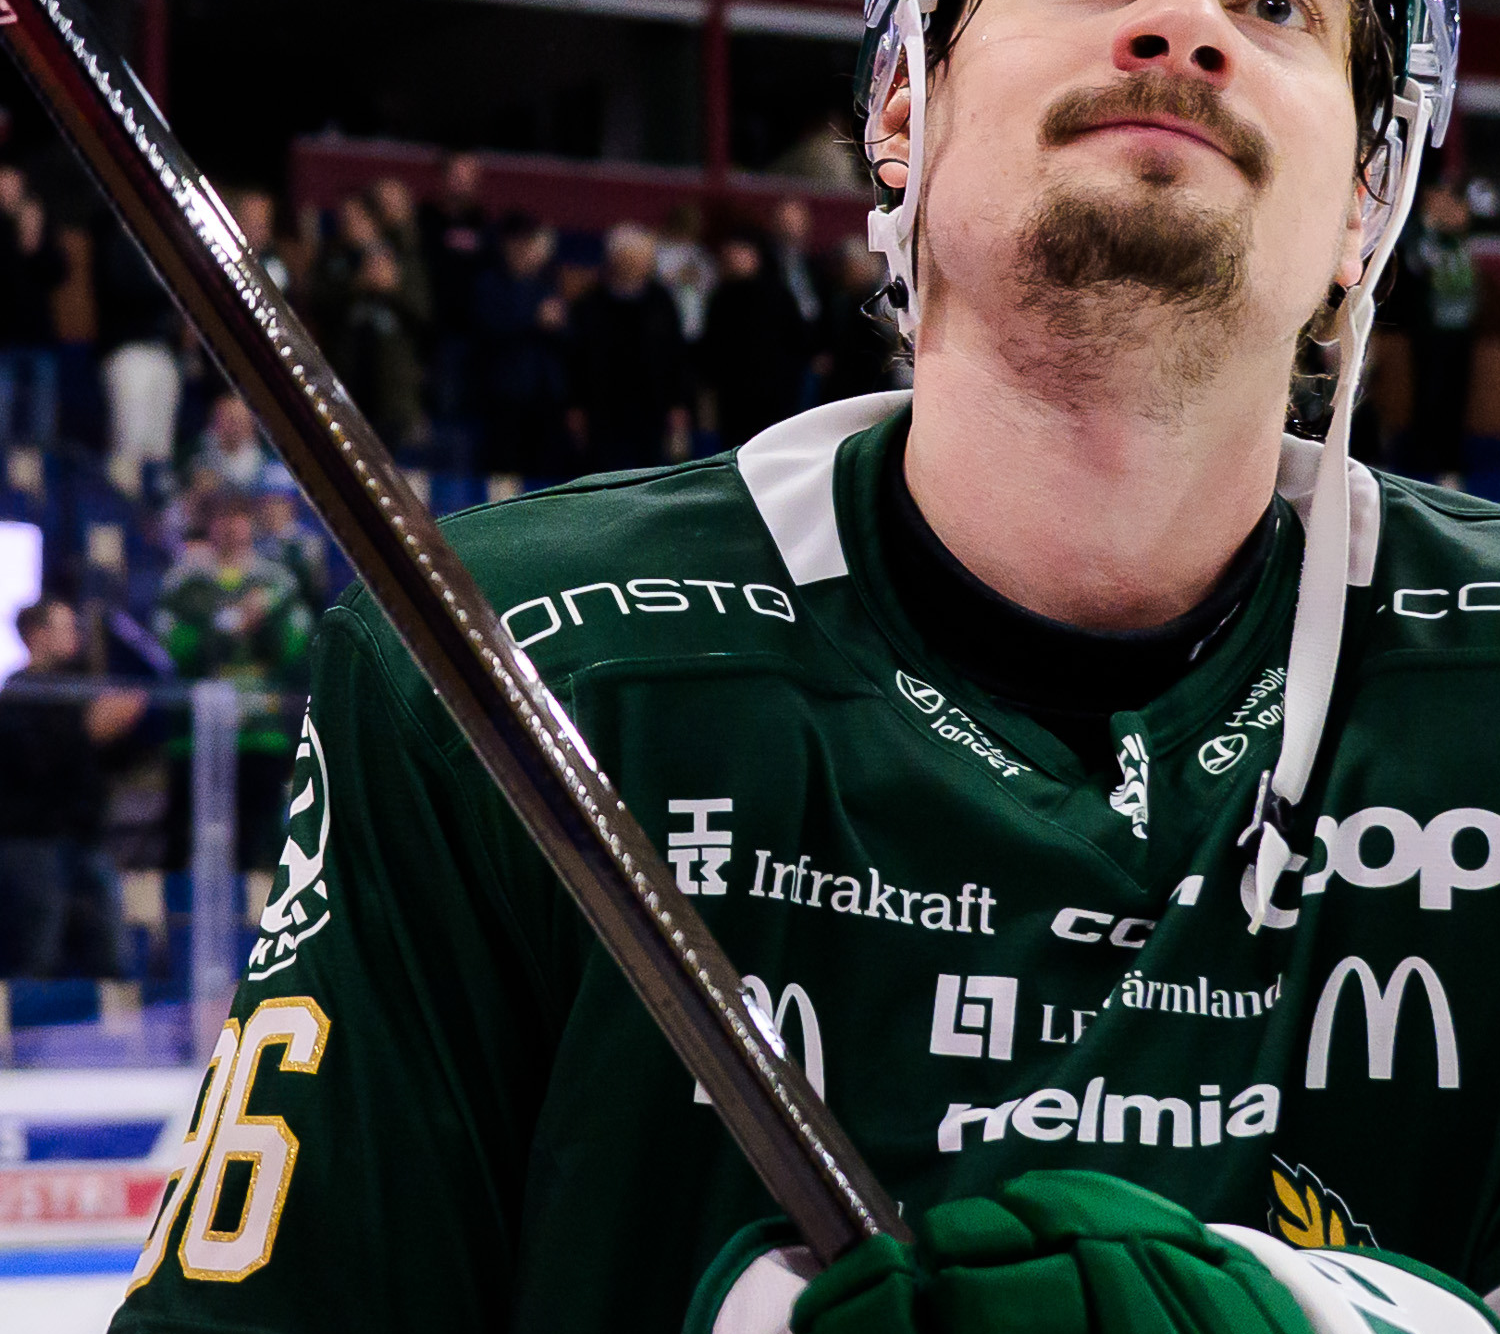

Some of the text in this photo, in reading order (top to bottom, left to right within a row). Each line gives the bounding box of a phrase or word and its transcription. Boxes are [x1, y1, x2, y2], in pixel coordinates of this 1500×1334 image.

[499, 577, 796, 650] ONSTO
[747, 848, 1000, 937] Infrakraft
[1101, 969, 1283, 1019] ärmland
